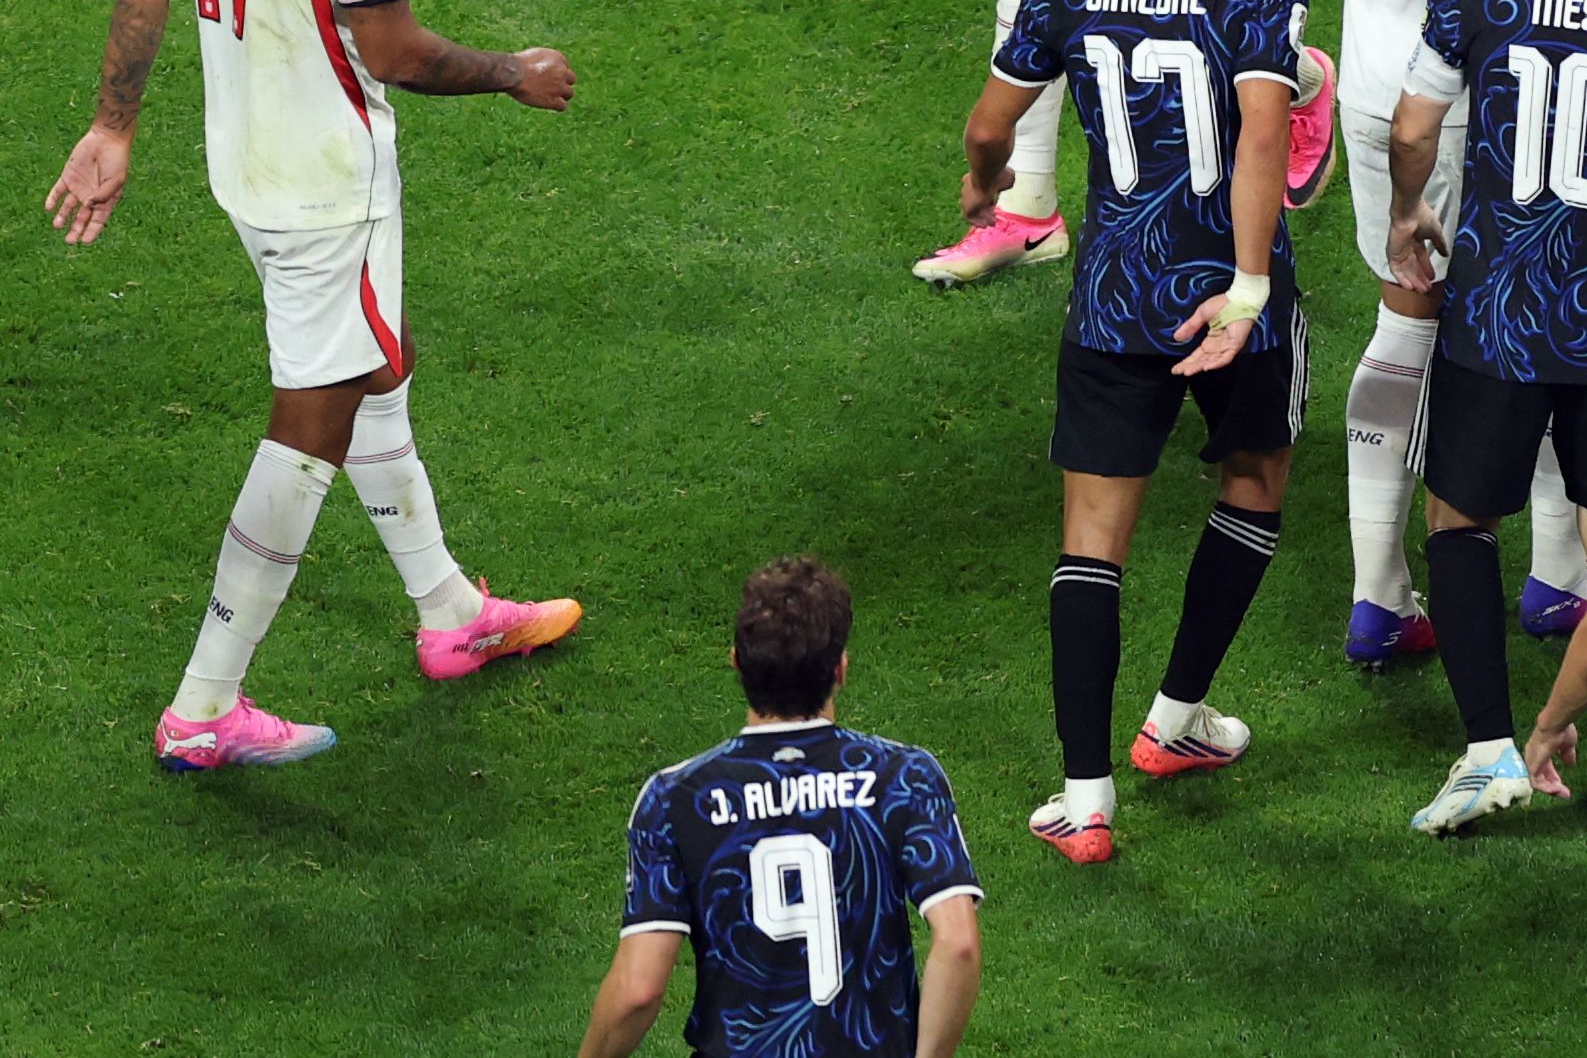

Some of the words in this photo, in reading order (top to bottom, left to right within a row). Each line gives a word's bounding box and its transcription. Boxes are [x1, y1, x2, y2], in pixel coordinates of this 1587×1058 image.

[1083, 34, 1224, 198] 17
[1347, 427, 1386, 447] ENG
[366, 504, 398, 518] ENG
[210, 595, 234, 625] ENG
[710, 786, 739, 827] J.
[744, 770, 877, 821] ALVAREZ
[748, 832, 844, 1007] 9
